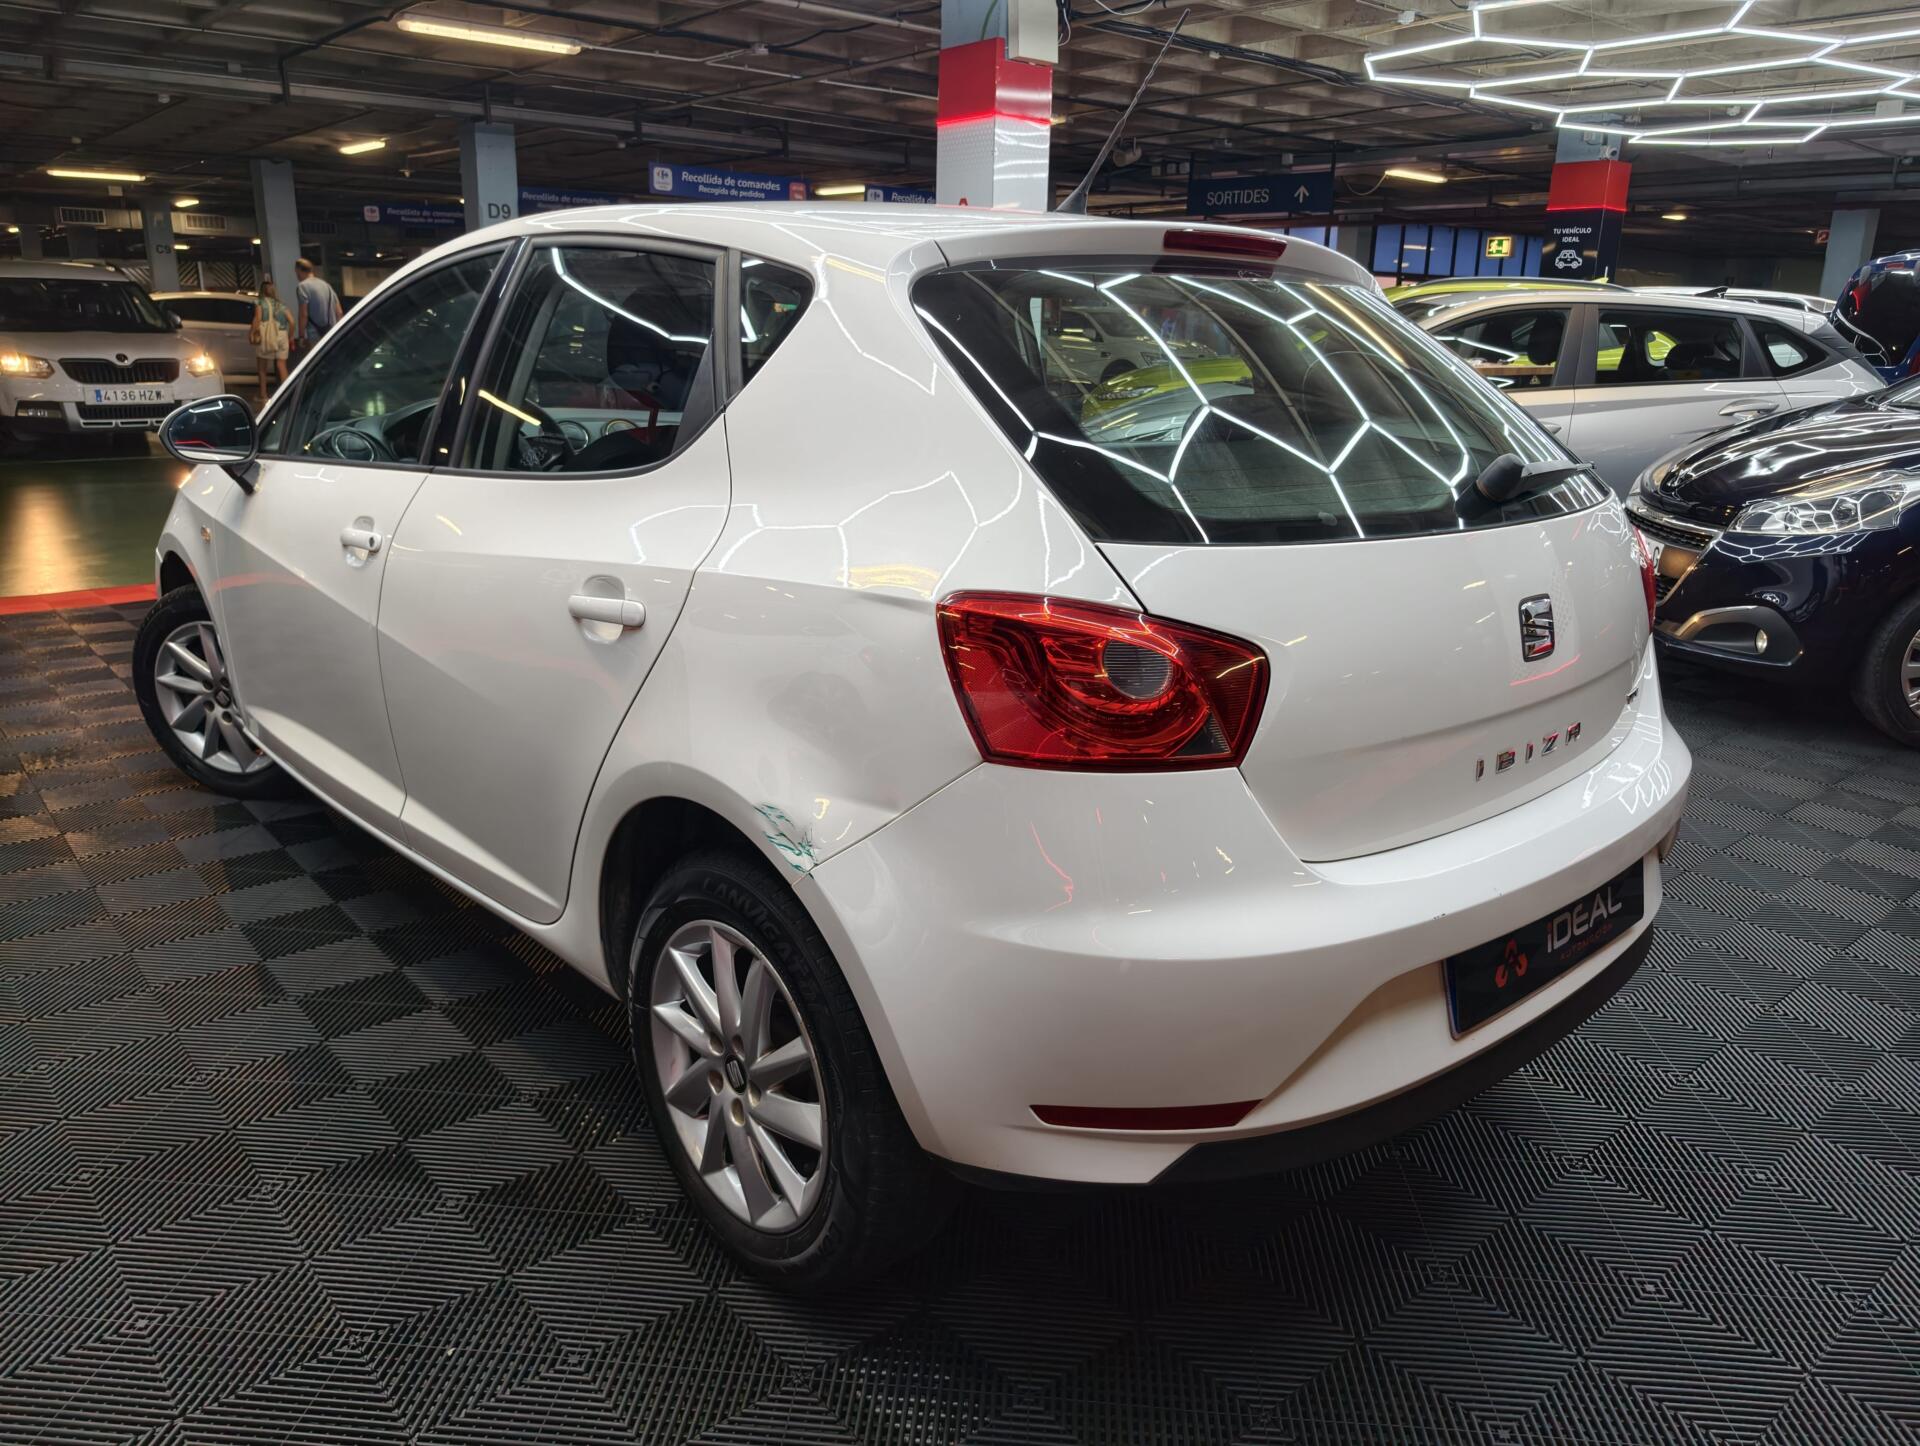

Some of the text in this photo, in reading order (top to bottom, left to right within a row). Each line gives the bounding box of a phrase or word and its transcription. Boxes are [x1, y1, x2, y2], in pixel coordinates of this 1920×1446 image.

[681, 170, 723, 186] Recollida
[724, 176, 736, 187] de
[737, 179, 781, 191] comandes
[698, 184, 766, 199] Recogida de pedidos
[1206, 188, 1270, 206] SORTIDES
[487, 203, 512, 219] D9
[1562, 226, 1592, 234] VEHÍCULO
[103, 389, 136, 401] 4136
[1475, 721, 1581, 782] IBIZA
